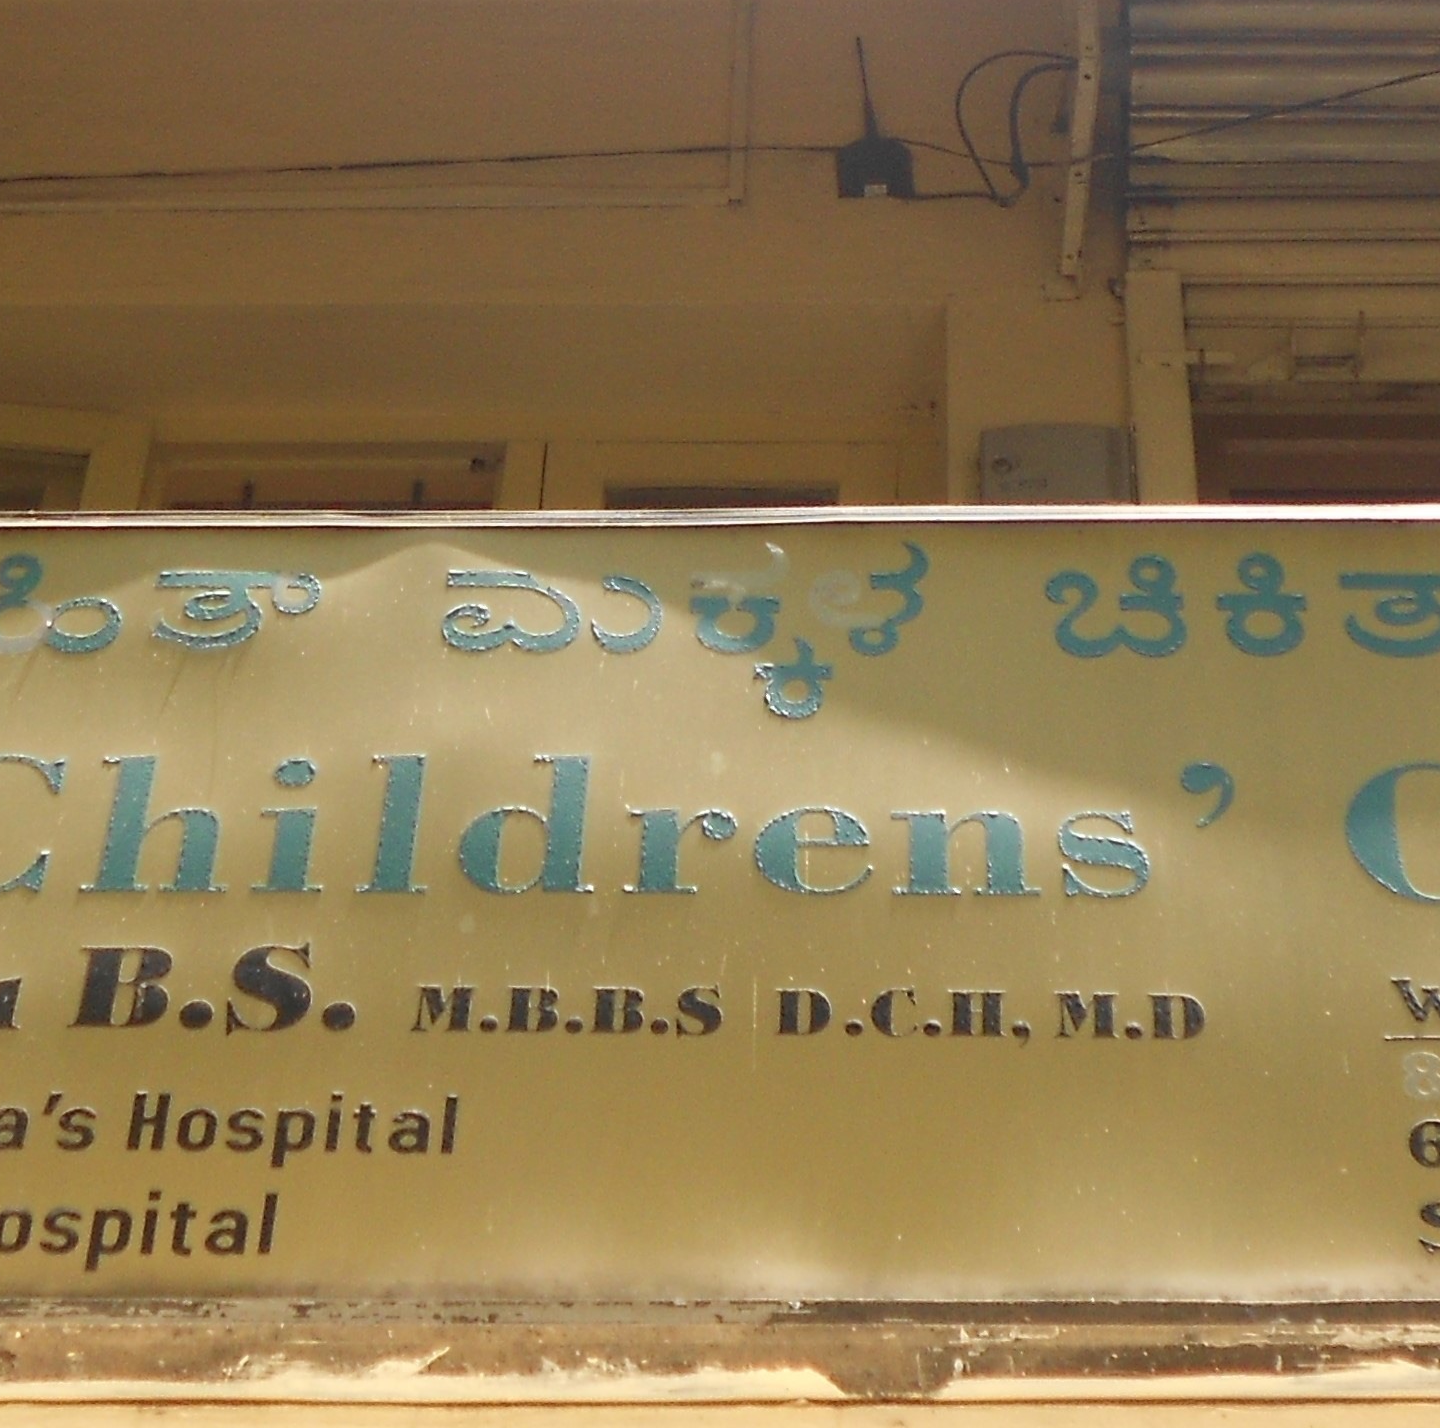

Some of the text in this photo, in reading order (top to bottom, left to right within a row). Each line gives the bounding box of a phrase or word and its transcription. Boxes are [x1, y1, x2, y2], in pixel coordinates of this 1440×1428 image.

[68, 942, 357, 1036] B.S.
[411, 982, 725, 1039] M.B.B.S
[1055, 990, 1207, 1041] M.D
[127, 1090, 460, 1168] Hospital
